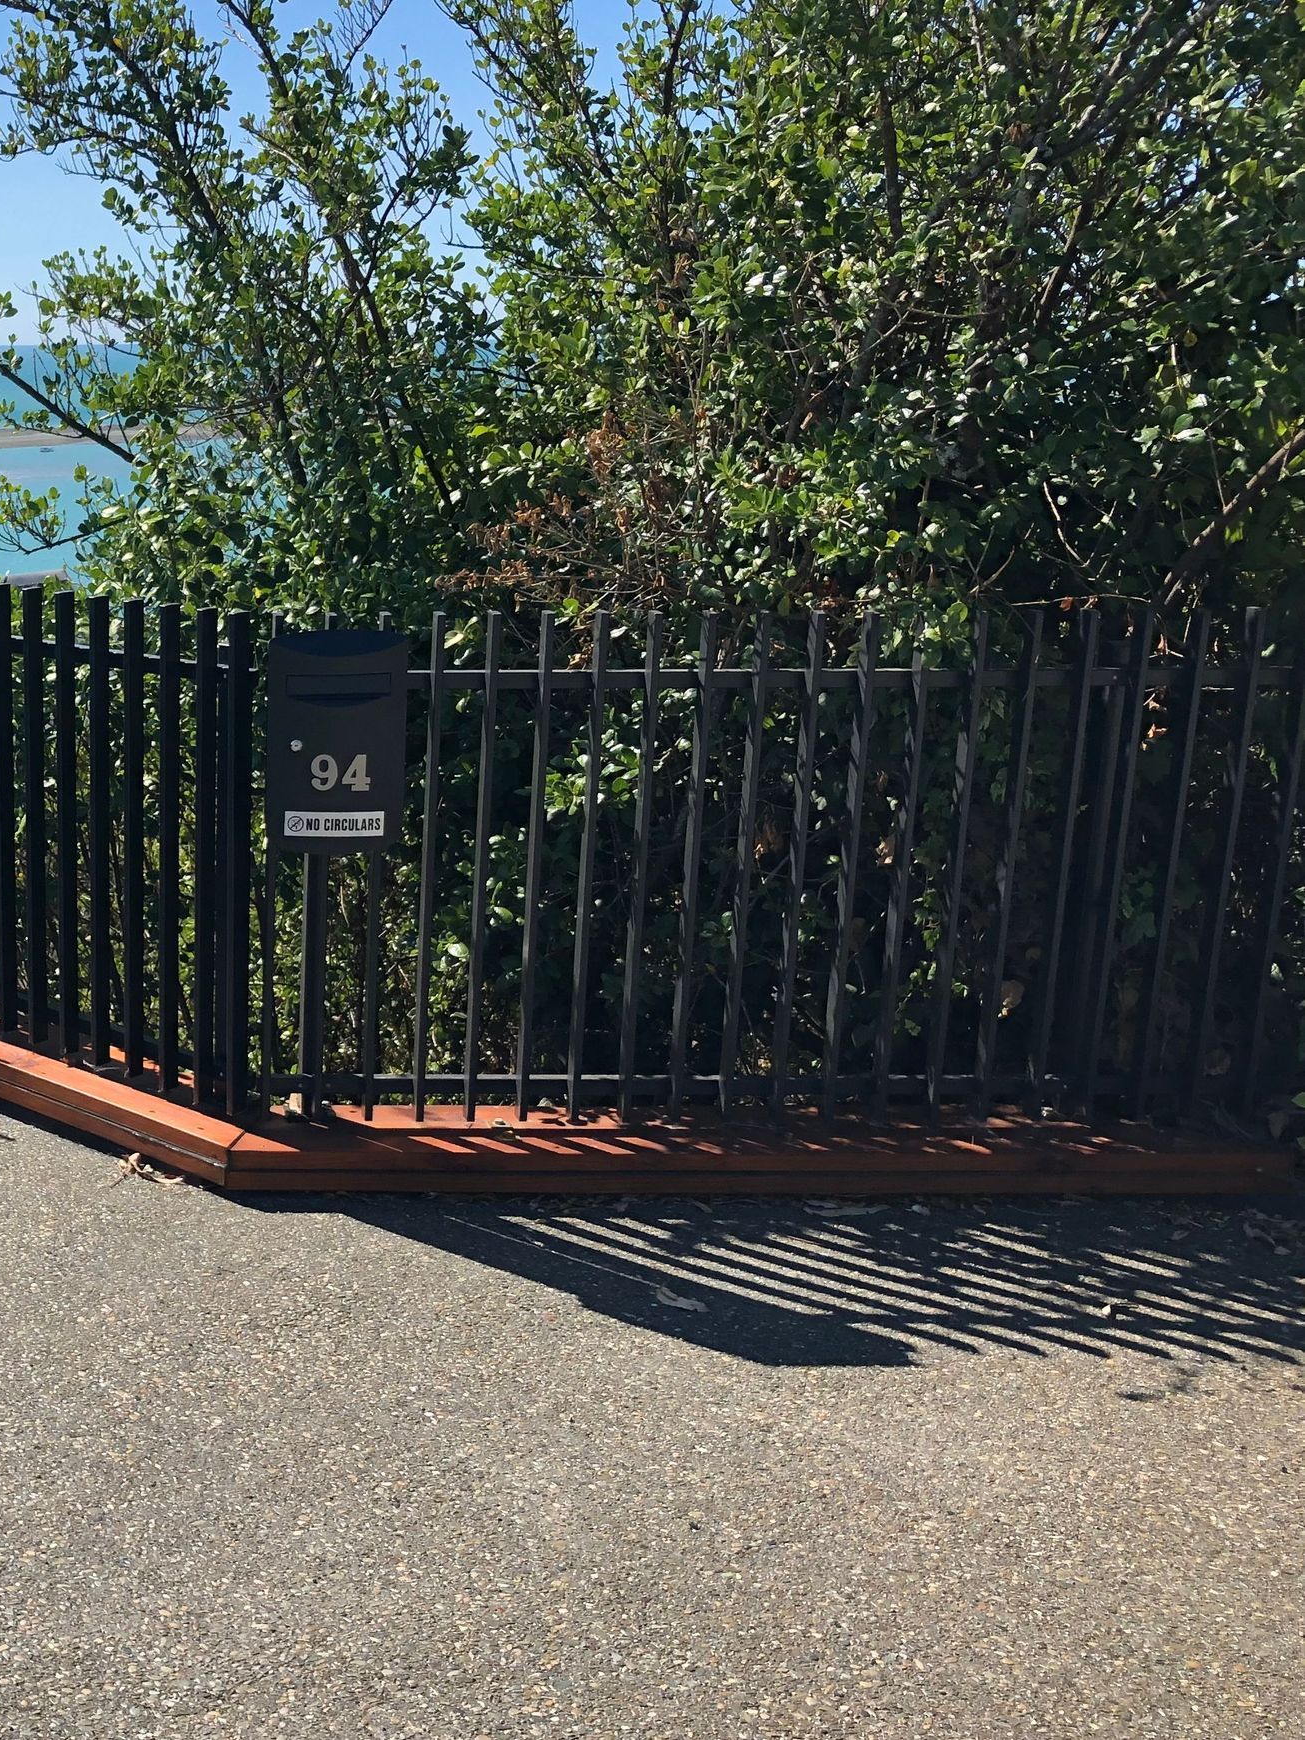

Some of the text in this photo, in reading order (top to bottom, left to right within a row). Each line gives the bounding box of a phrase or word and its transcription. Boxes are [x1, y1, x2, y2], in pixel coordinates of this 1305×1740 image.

[310, 753, 371, 792] 94
[305, 818, 381, 831] NO CIRCULARS
